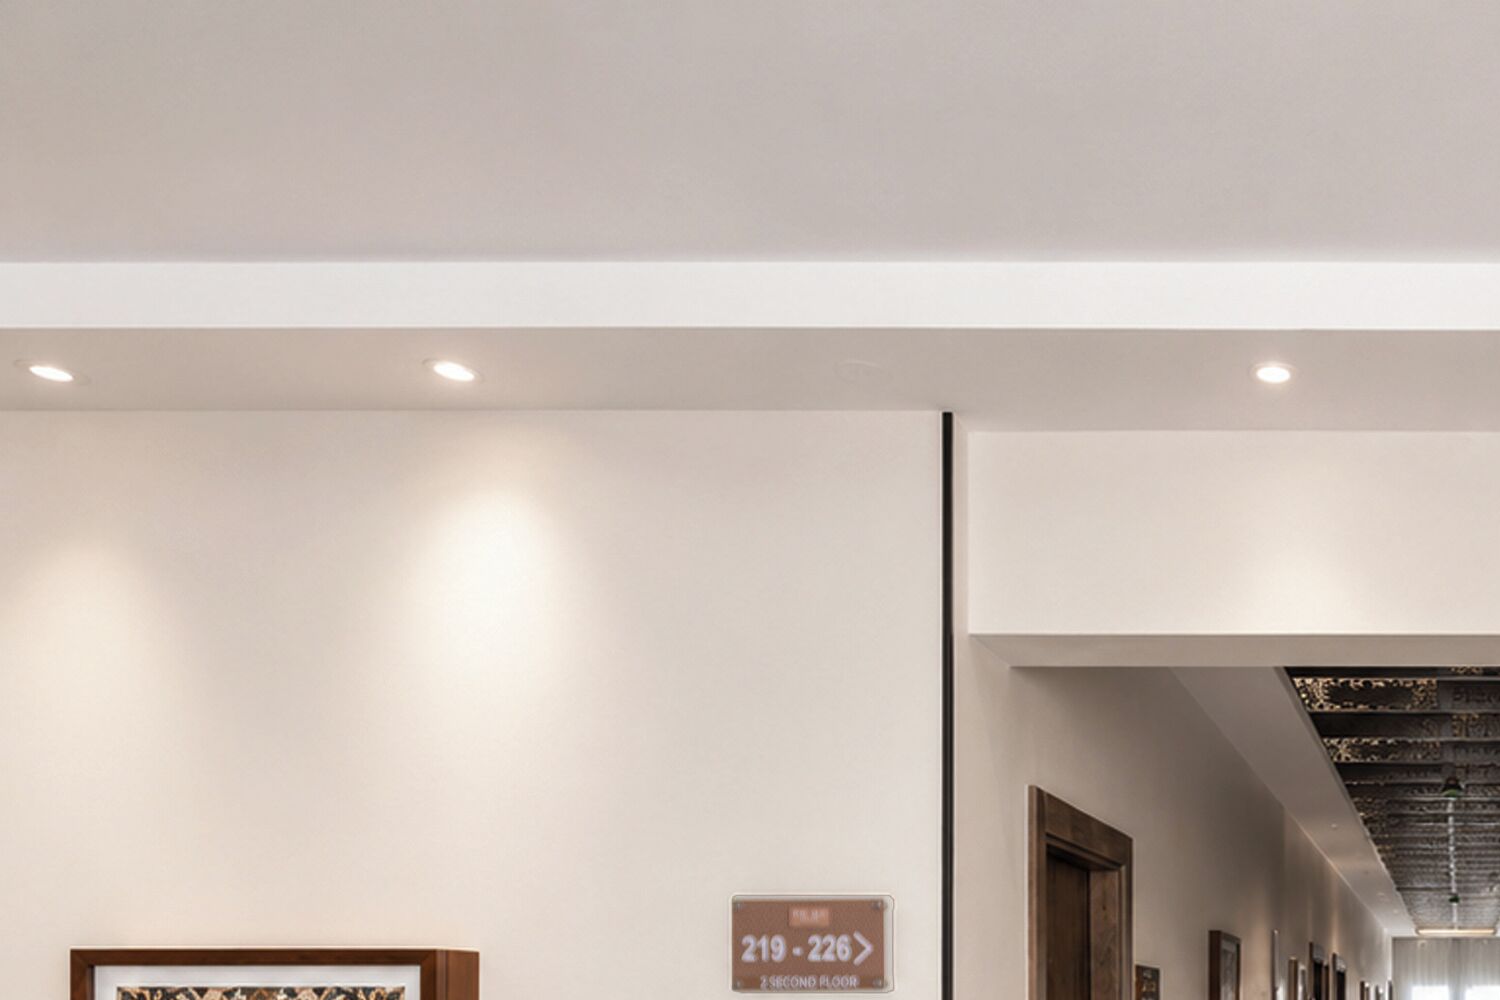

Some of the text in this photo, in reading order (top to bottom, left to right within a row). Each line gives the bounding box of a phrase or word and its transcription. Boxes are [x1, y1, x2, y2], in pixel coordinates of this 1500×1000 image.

[741, 934, 786, 962] 219
[807, 934, 852, 962] 226
[819, 975, 857, 988] FLOOR
